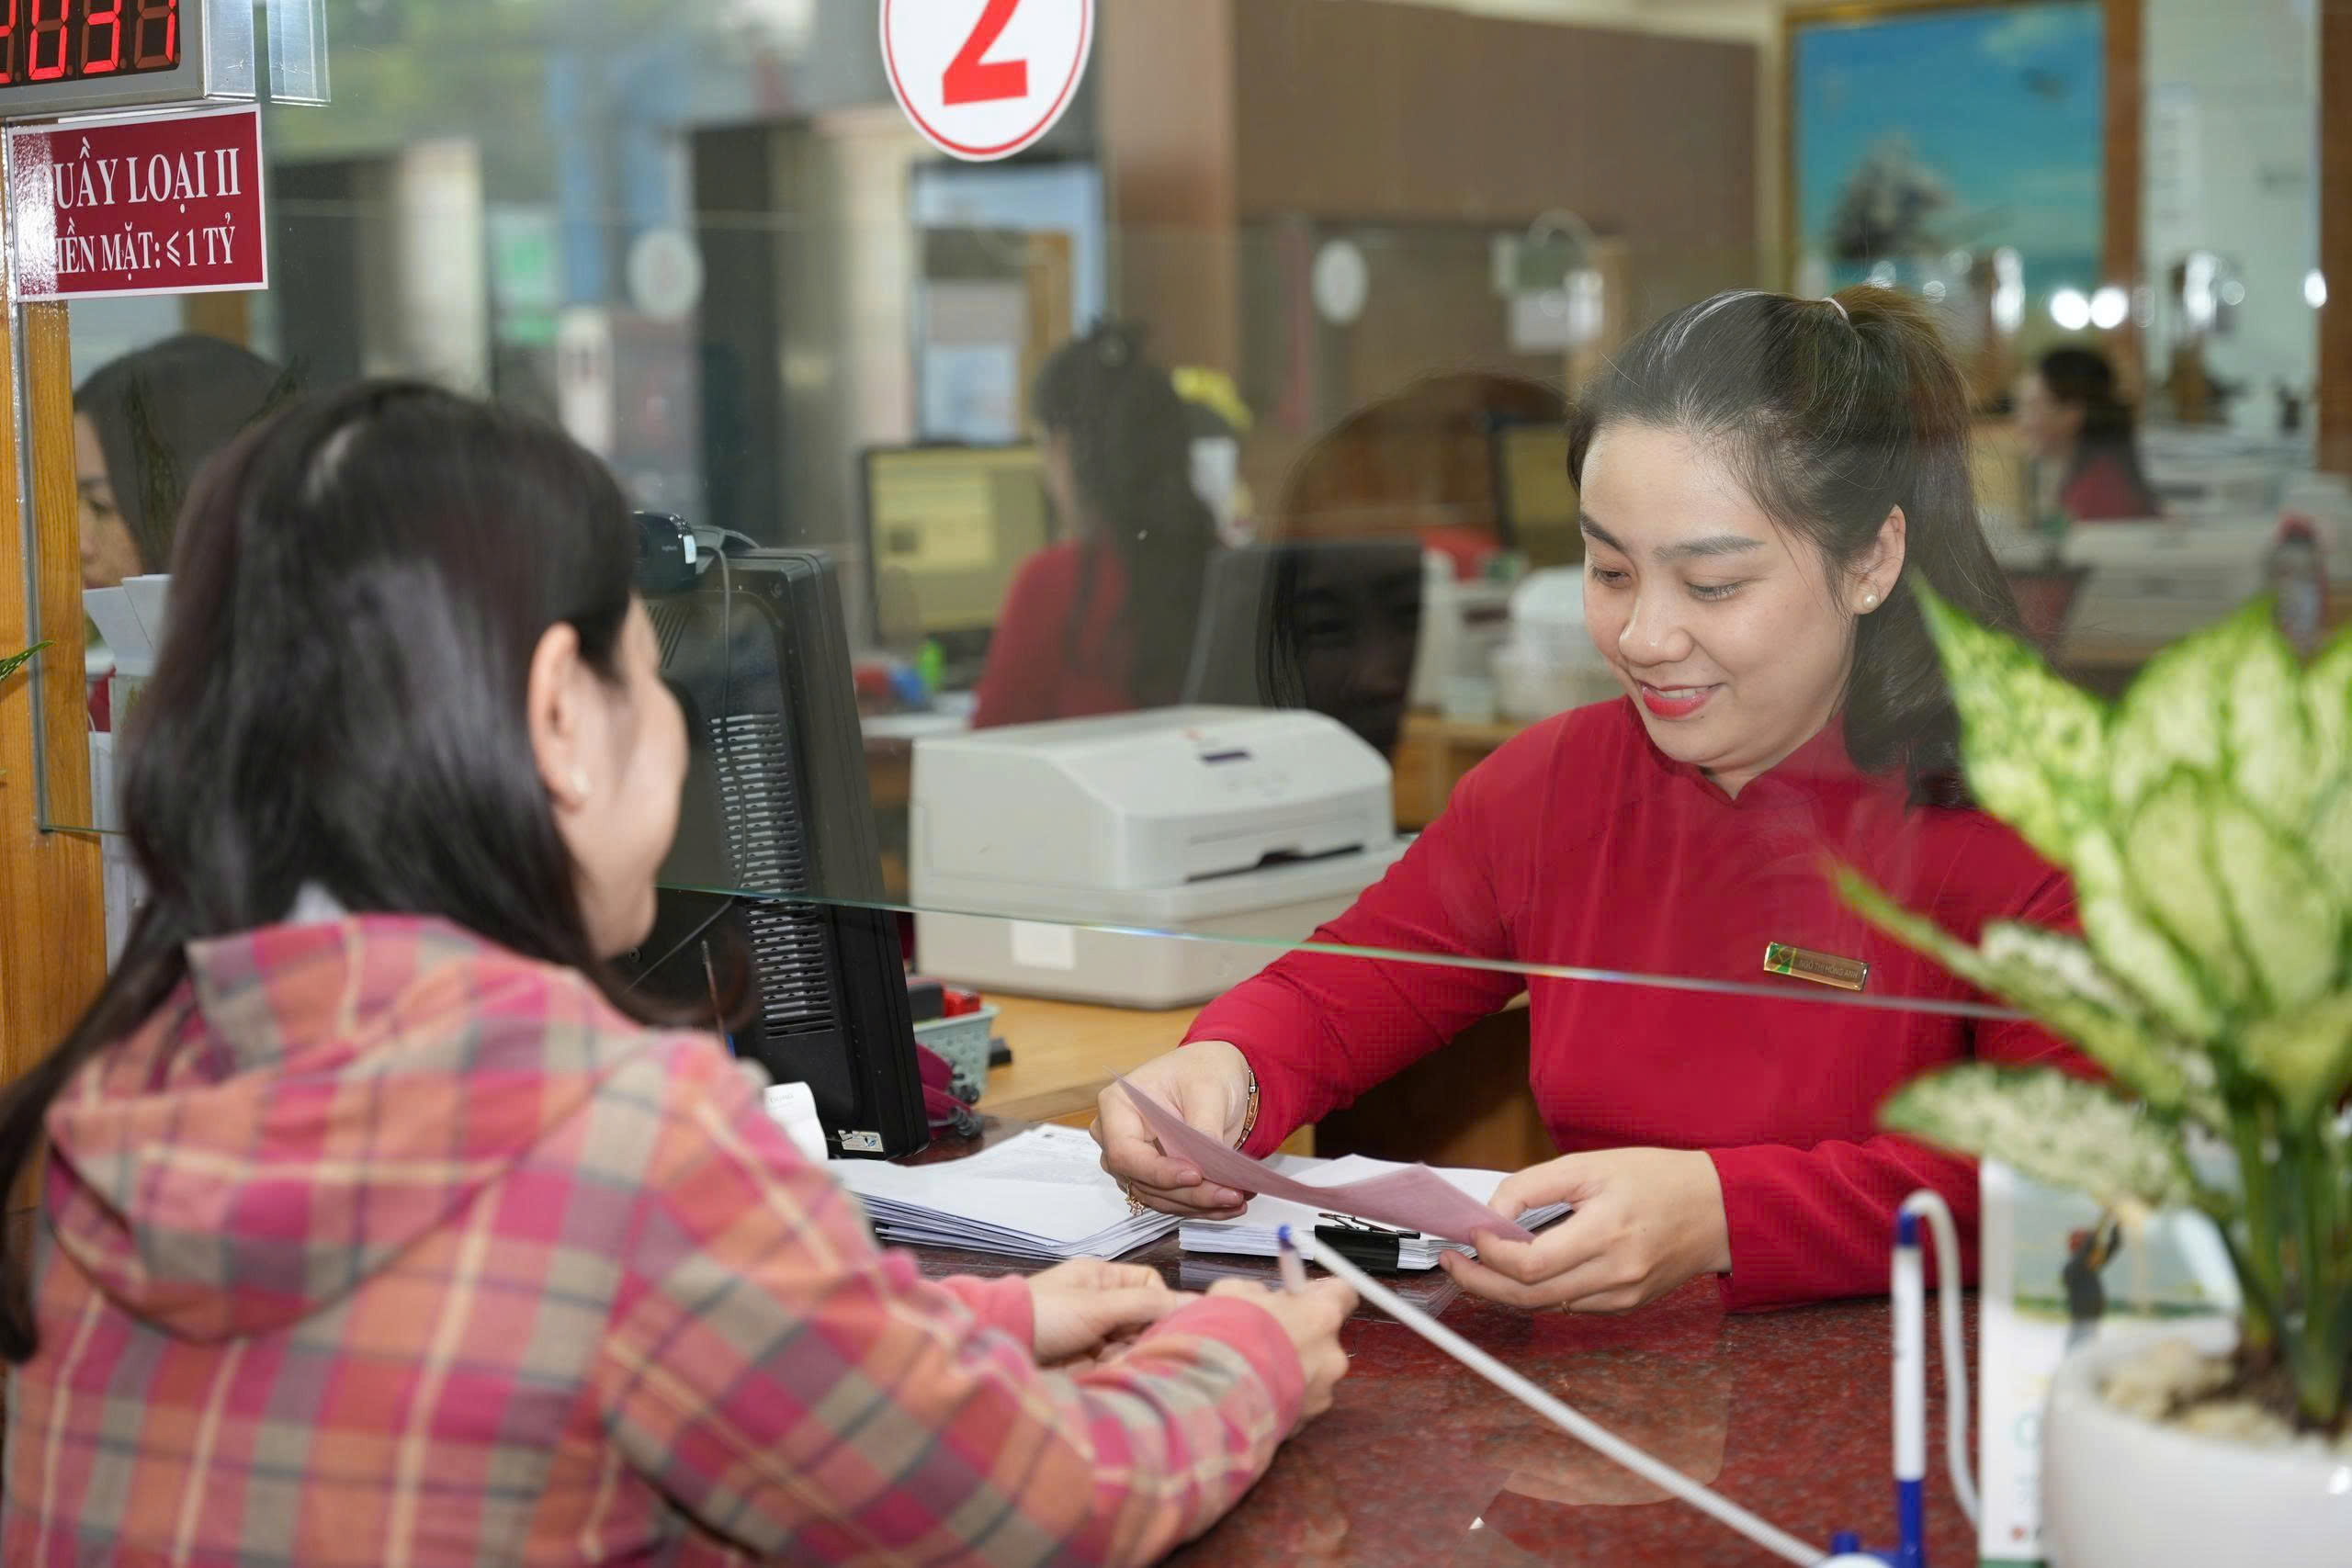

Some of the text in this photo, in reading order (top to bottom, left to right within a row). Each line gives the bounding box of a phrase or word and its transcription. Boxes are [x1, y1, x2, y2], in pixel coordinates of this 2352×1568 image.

[942, 0, 1028, 107] 2
[126, 152, 208, 214] LOẠI
[214, 148, 241, 196] II
[54, 217, 95, 275] IỀN
[100, 221, 160, 280] MẶT:
[203, 211, 235, 265] TỶ
